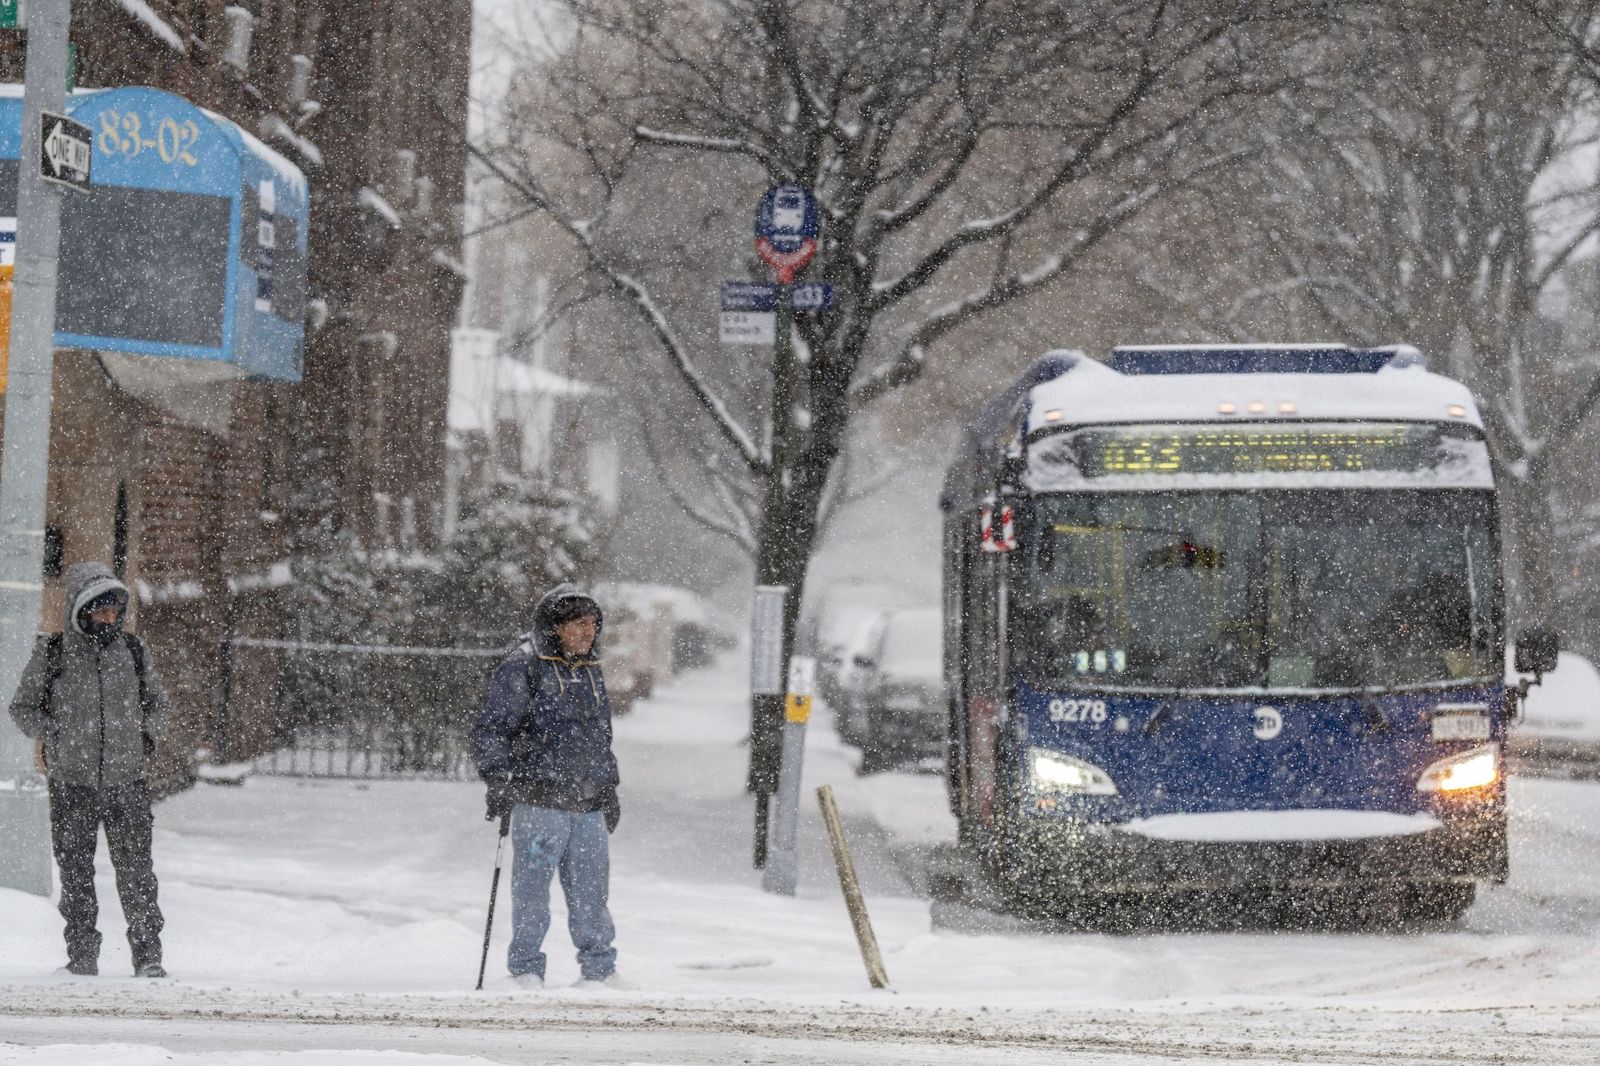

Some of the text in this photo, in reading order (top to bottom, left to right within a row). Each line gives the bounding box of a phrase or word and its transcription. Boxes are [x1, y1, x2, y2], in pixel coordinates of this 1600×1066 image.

[52, 134, 70, 163] ONE
[99, 111, 198, 166] 83-02
[1049, 698, 1107, 723] 9278
